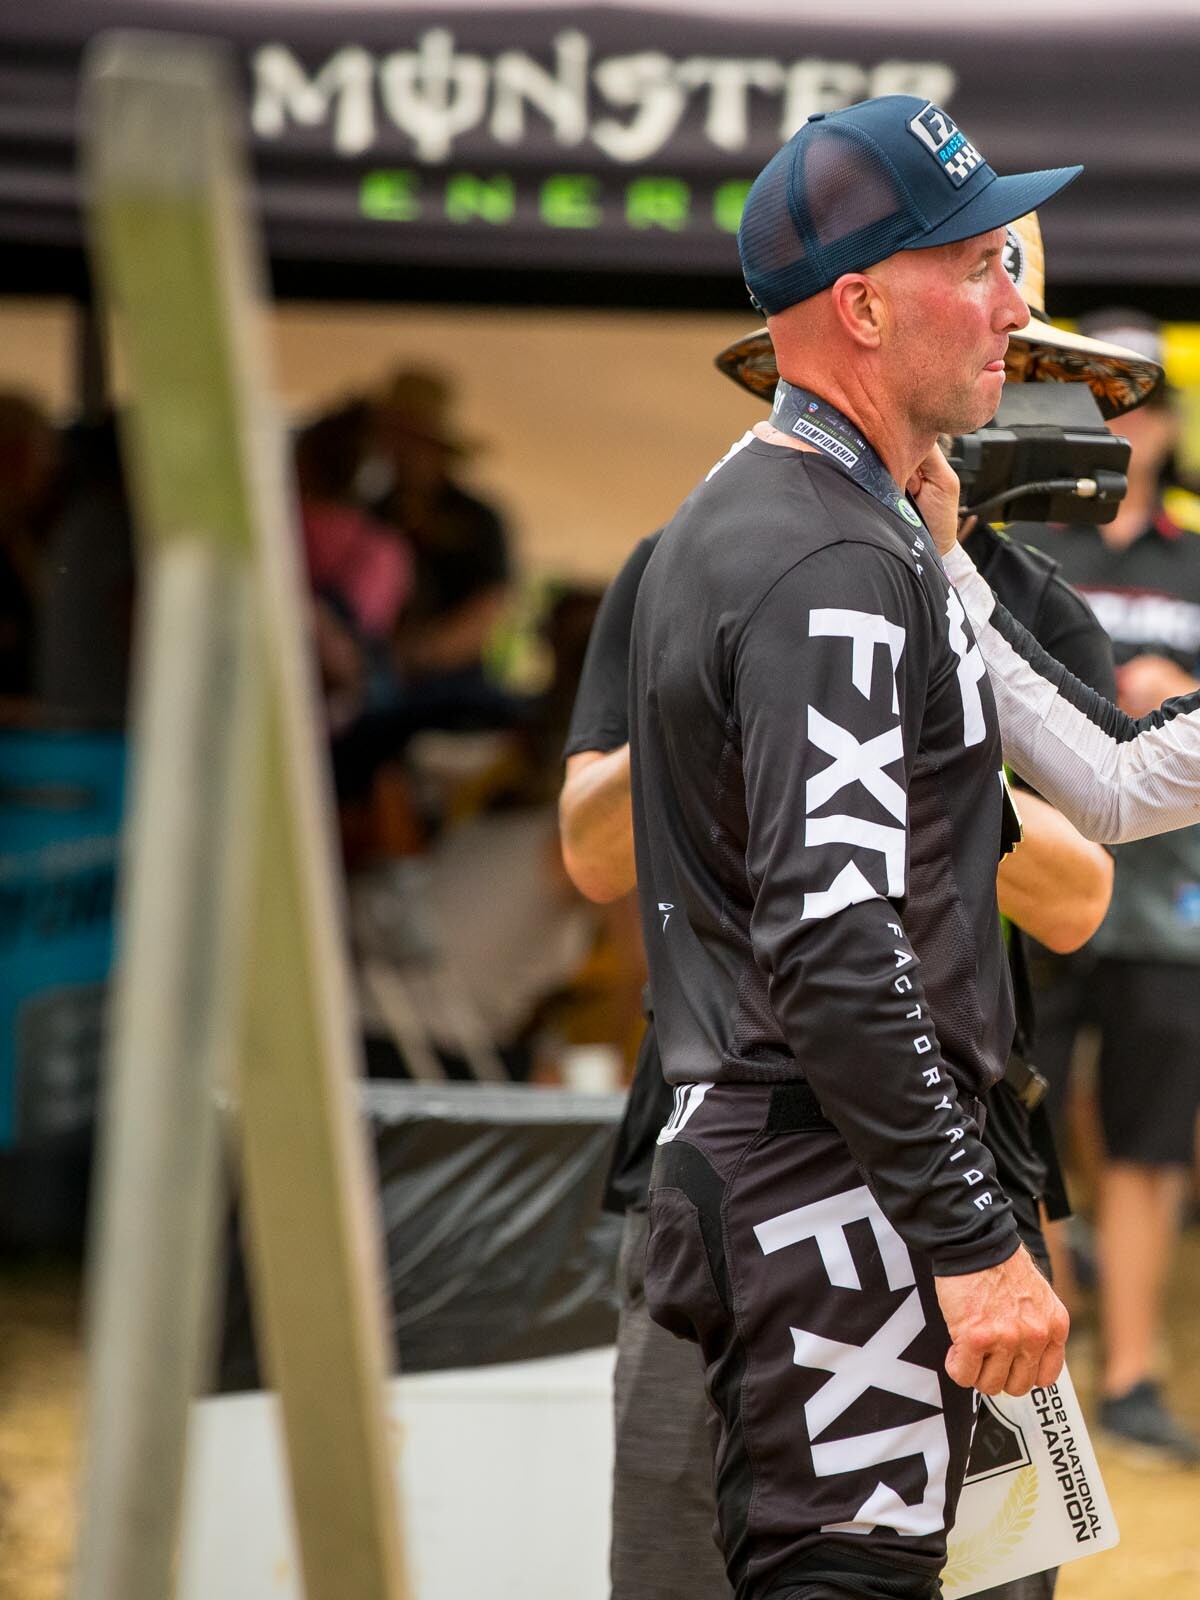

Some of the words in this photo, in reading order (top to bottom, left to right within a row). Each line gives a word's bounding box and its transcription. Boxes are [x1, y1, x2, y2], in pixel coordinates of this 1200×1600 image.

[360, 170, 750, 232] ENER
[794, 421, 856, 464] CHAMPIONSHIP
[801, 608, 907, 921] FXR
[752, 1184, 951, 1538] FXR
[1030, 1387, 1091, 1544] CHAMPION
[1048, 1382, 1072, 1436] 2021
[1063, 1436, 1102, 1539] NATIONAL
